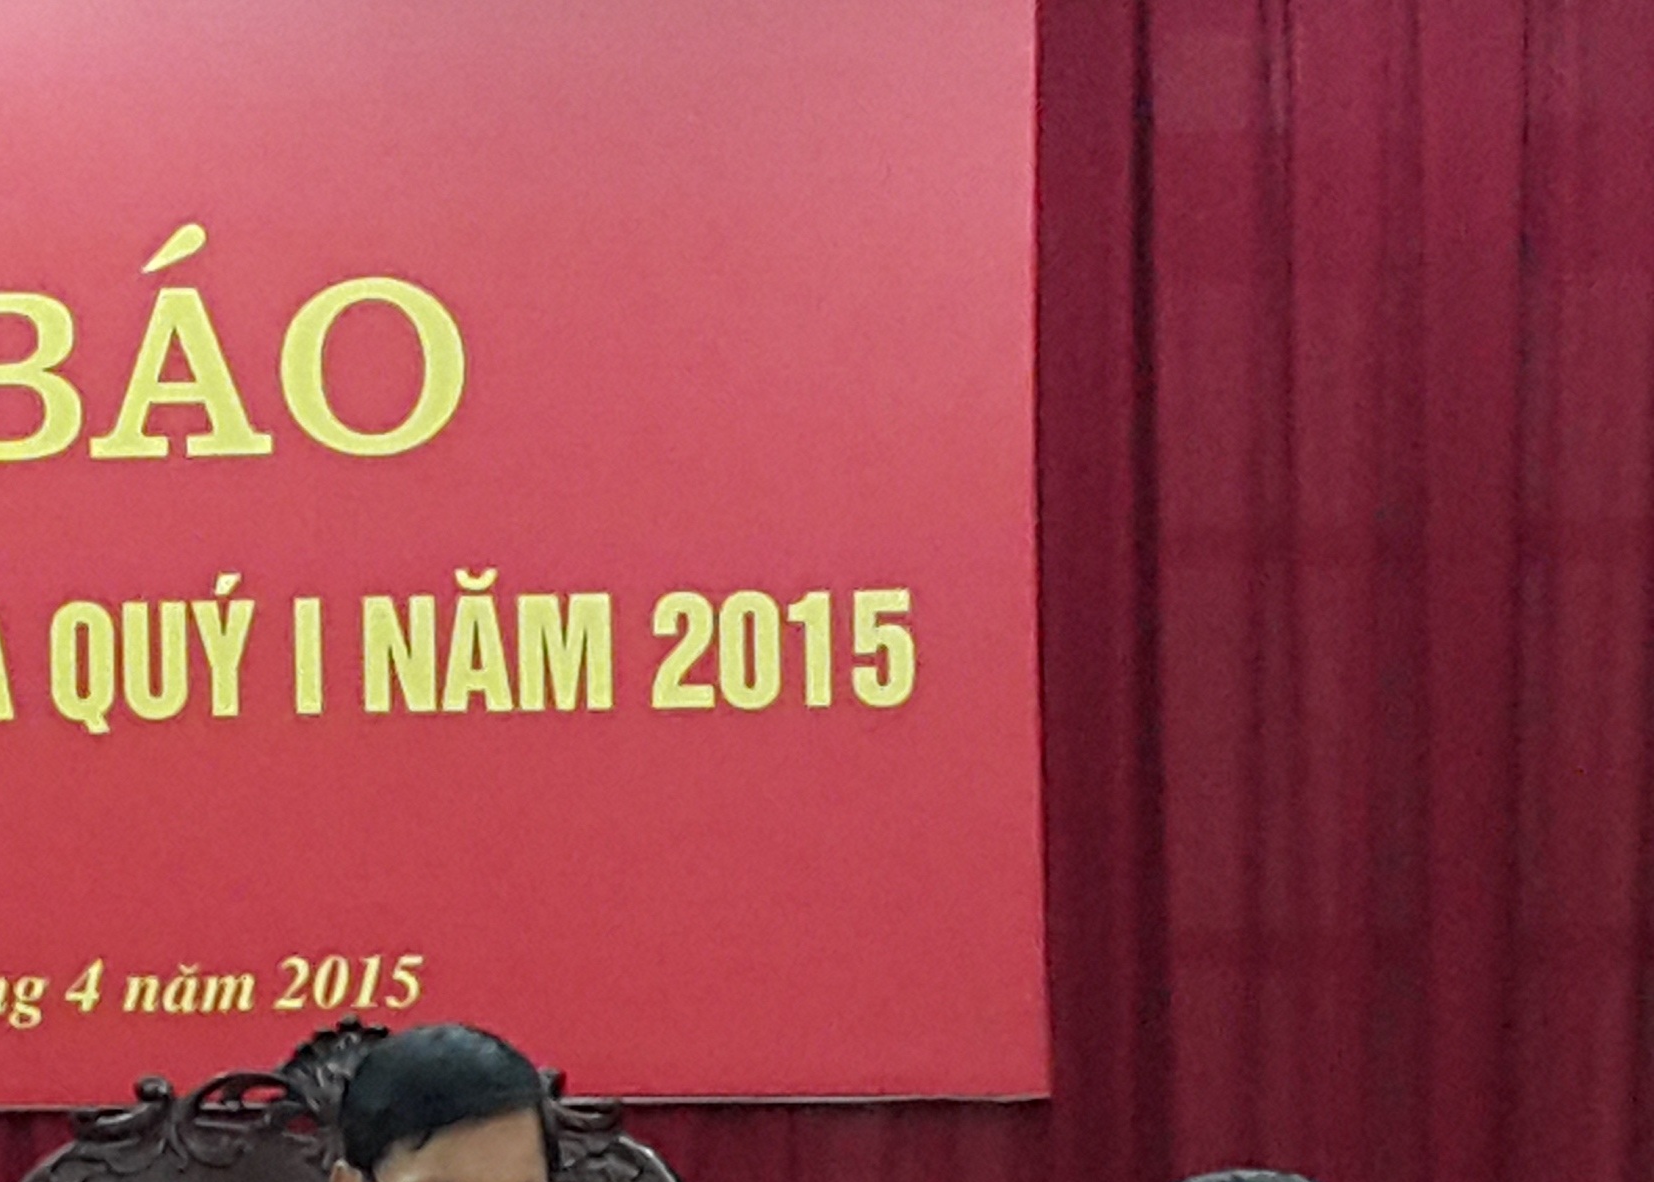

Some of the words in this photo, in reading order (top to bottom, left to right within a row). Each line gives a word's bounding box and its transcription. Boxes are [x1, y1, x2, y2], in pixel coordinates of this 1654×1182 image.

[49, 572, 256, 735] QUÝ
[294, 597, 324, 716] I
[362, 567, 614, 713] NĂM
[651, 587, 916, 711] 2015
[64, 958, 104, 1013] 4
[122, 963, 256, 1014] năm
[274, 954, 424, 1010] 2015
